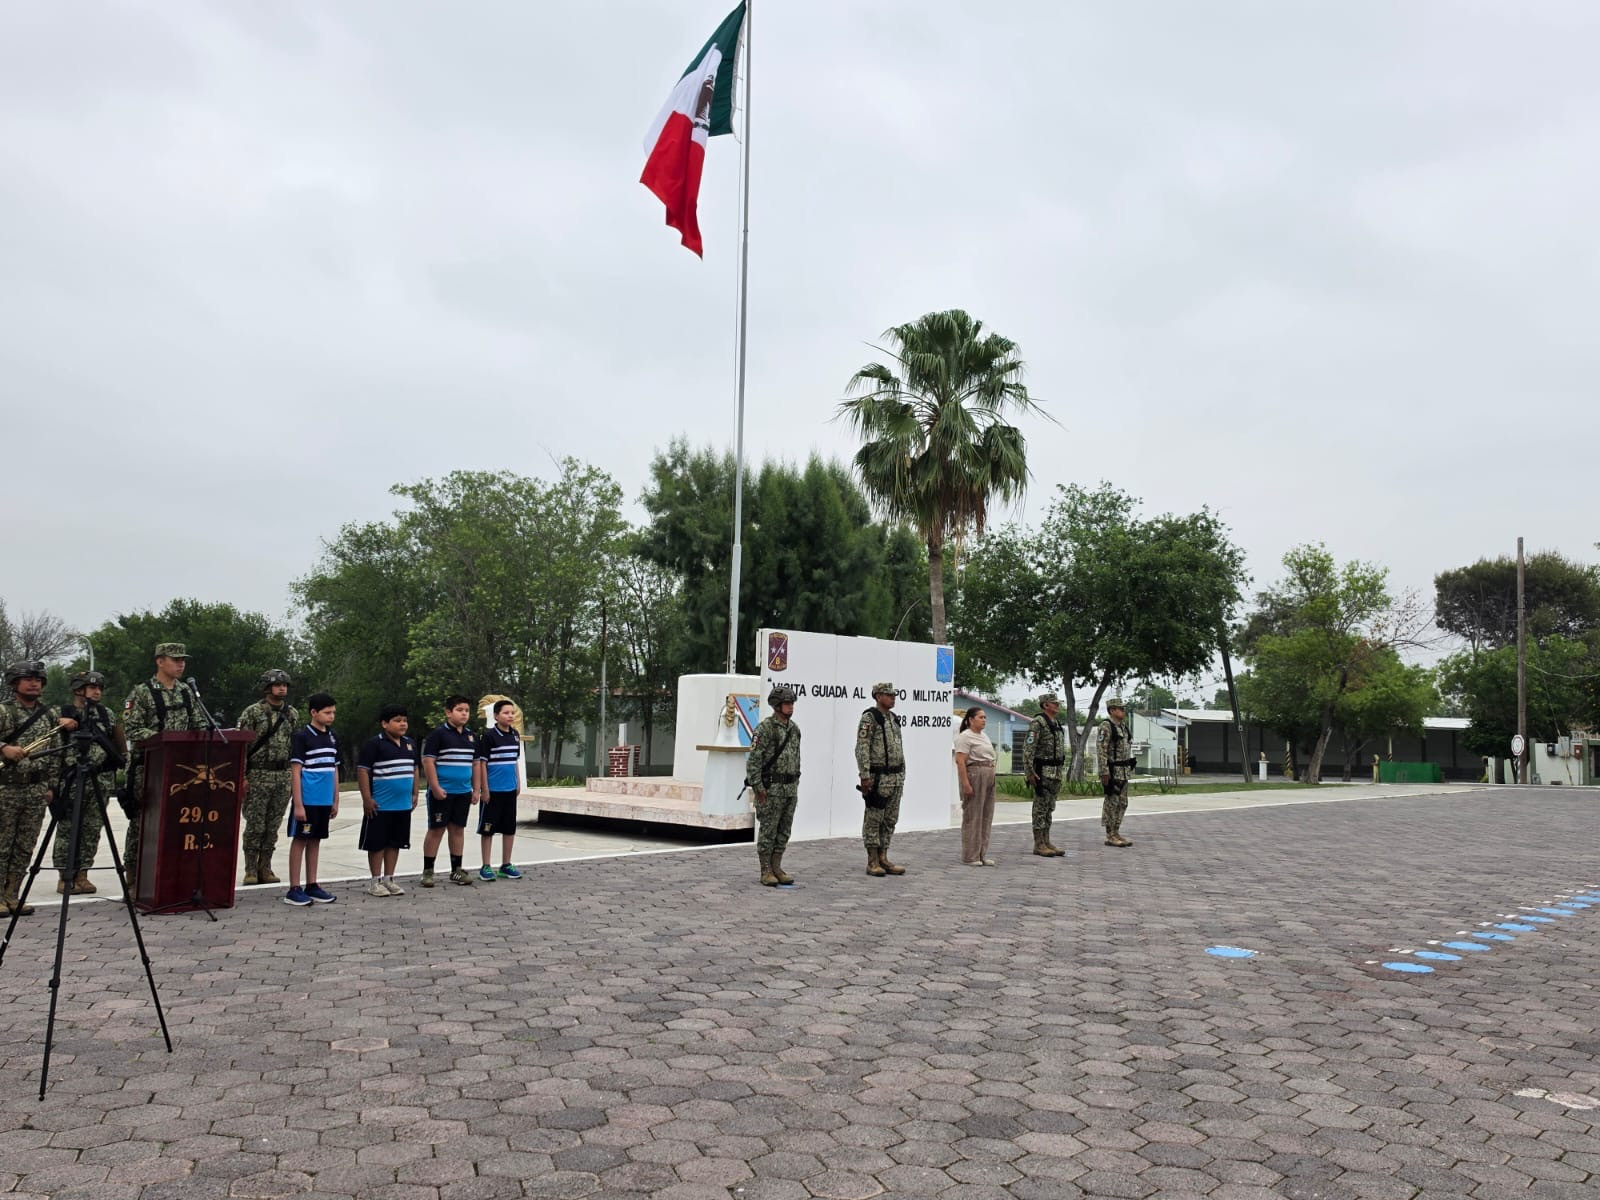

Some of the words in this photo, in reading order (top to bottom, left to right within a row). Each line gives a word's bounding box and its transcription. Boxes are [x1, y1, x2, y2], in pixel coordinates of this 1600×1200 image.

[811, 684, 848, 699] GUIADA
[853, 686, 866, 700] AL
[931, 715, 952, 728] 2026
